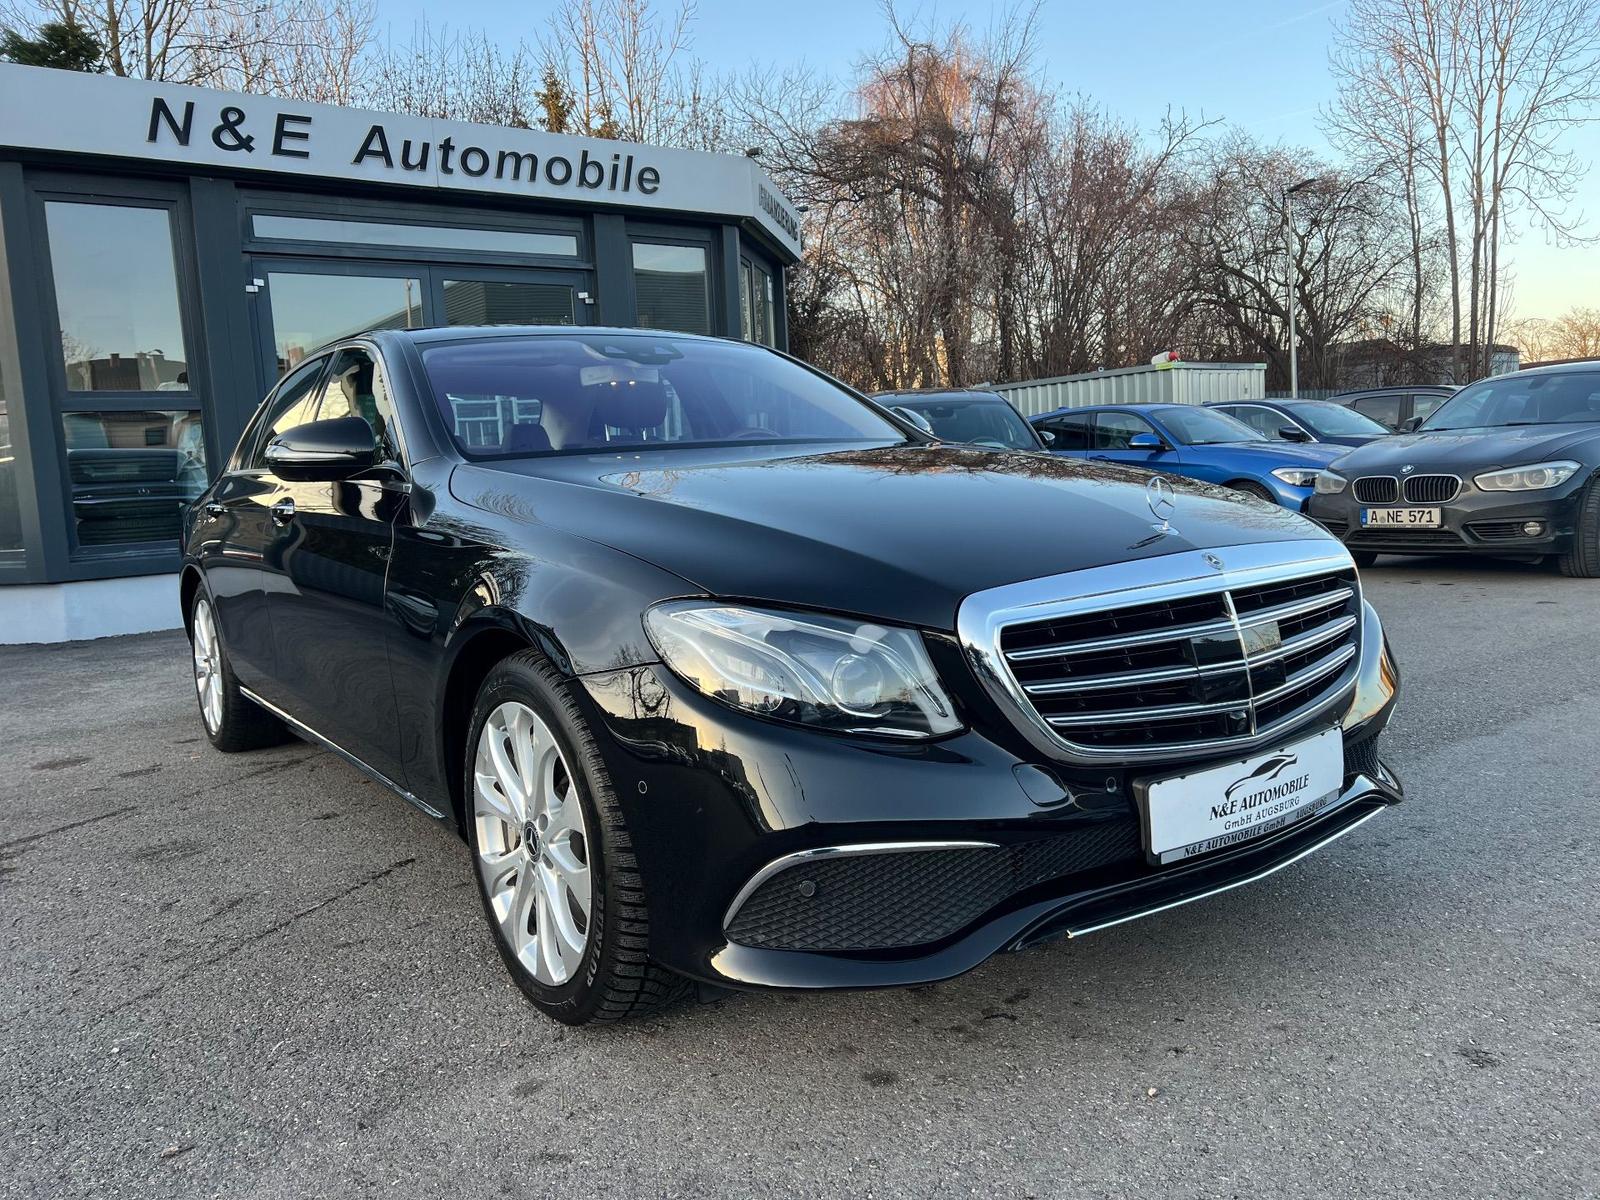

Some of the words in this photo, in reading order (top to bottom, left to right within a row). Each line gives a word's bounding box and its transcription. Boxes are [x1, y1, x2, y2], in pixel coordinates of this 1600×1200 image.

[351, 125, 661, 195] Automobile
[1370, 510, 1378, 523] A
[1386, 510, 1403, 523] NE
[1408, 510, 1434, 523] 571
[1209, 800, 1238, 821] N&E
[1239, 773, 1310, 810] AUTOMOBILE
[1224, 814, 1253, 831] GmbH
[1254, 796, 1300, 821] AUGSBURG
[1183, 843, 1204, 857] N&E
[1204, 825, 1263, 851] AUTOMOBILE
[1263, 817, 1286, 833] GmbH
[1295, 796, 1328, 820] AUGSBURG
[586, 894, 604, 987] DUNLOP
